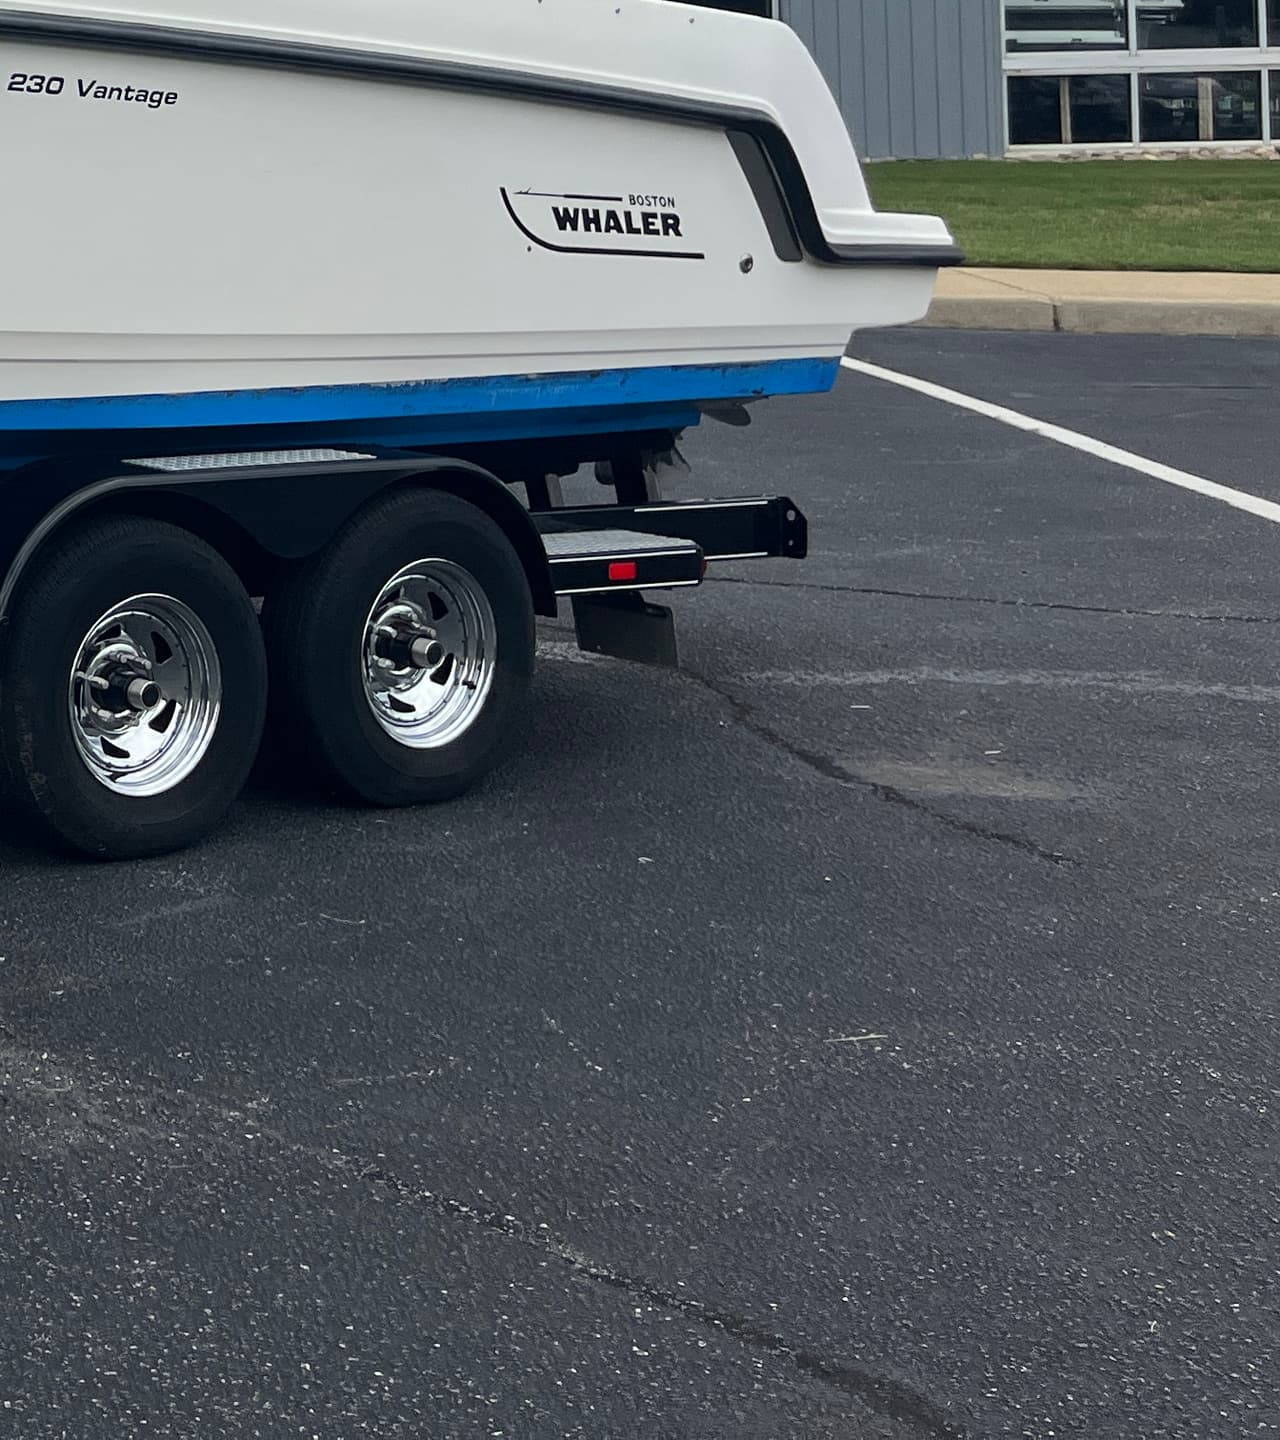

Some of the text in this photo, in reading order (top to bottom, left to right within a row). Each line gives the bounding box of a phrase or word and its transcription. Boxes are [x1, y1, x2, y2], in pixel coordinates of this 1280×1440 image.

[6, 72, 179, 109] 230 Vantage
[628, 194, 676, 209] BOSTON
[551, 206, 683, 237] WHALER
